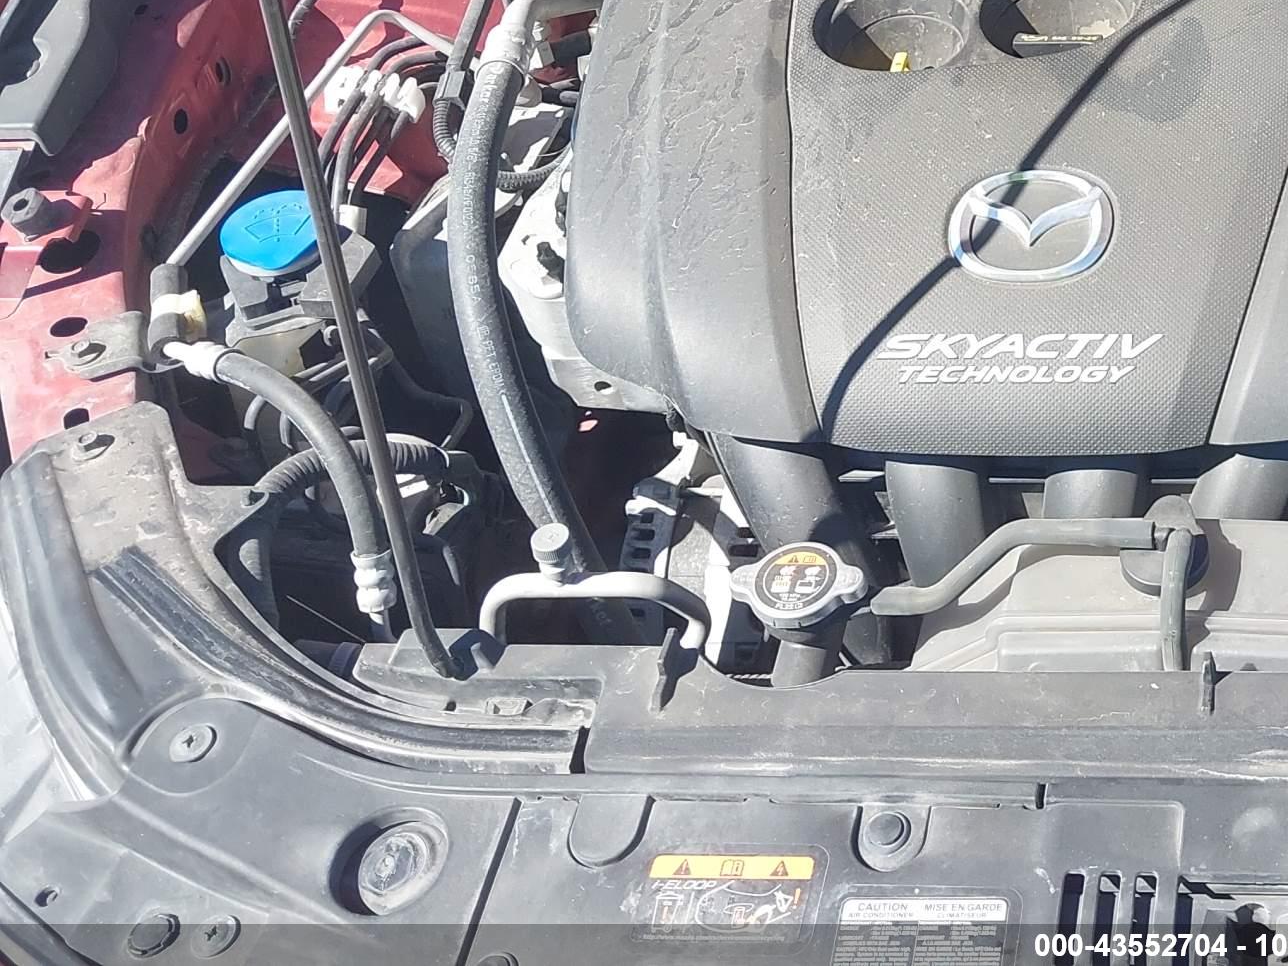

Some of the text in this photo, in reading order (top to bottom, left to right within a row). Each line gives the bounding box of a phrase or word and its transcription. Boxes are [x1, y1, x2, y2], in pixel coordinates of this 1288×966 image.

[876, 333, 1166, 360] SKYACTIV
[898, 365, 1136, 385] TECHNOLOGY
[857, 902, 909, 912] CAUTION
[924, 903, 1003, 912] MISE EN GARDE
